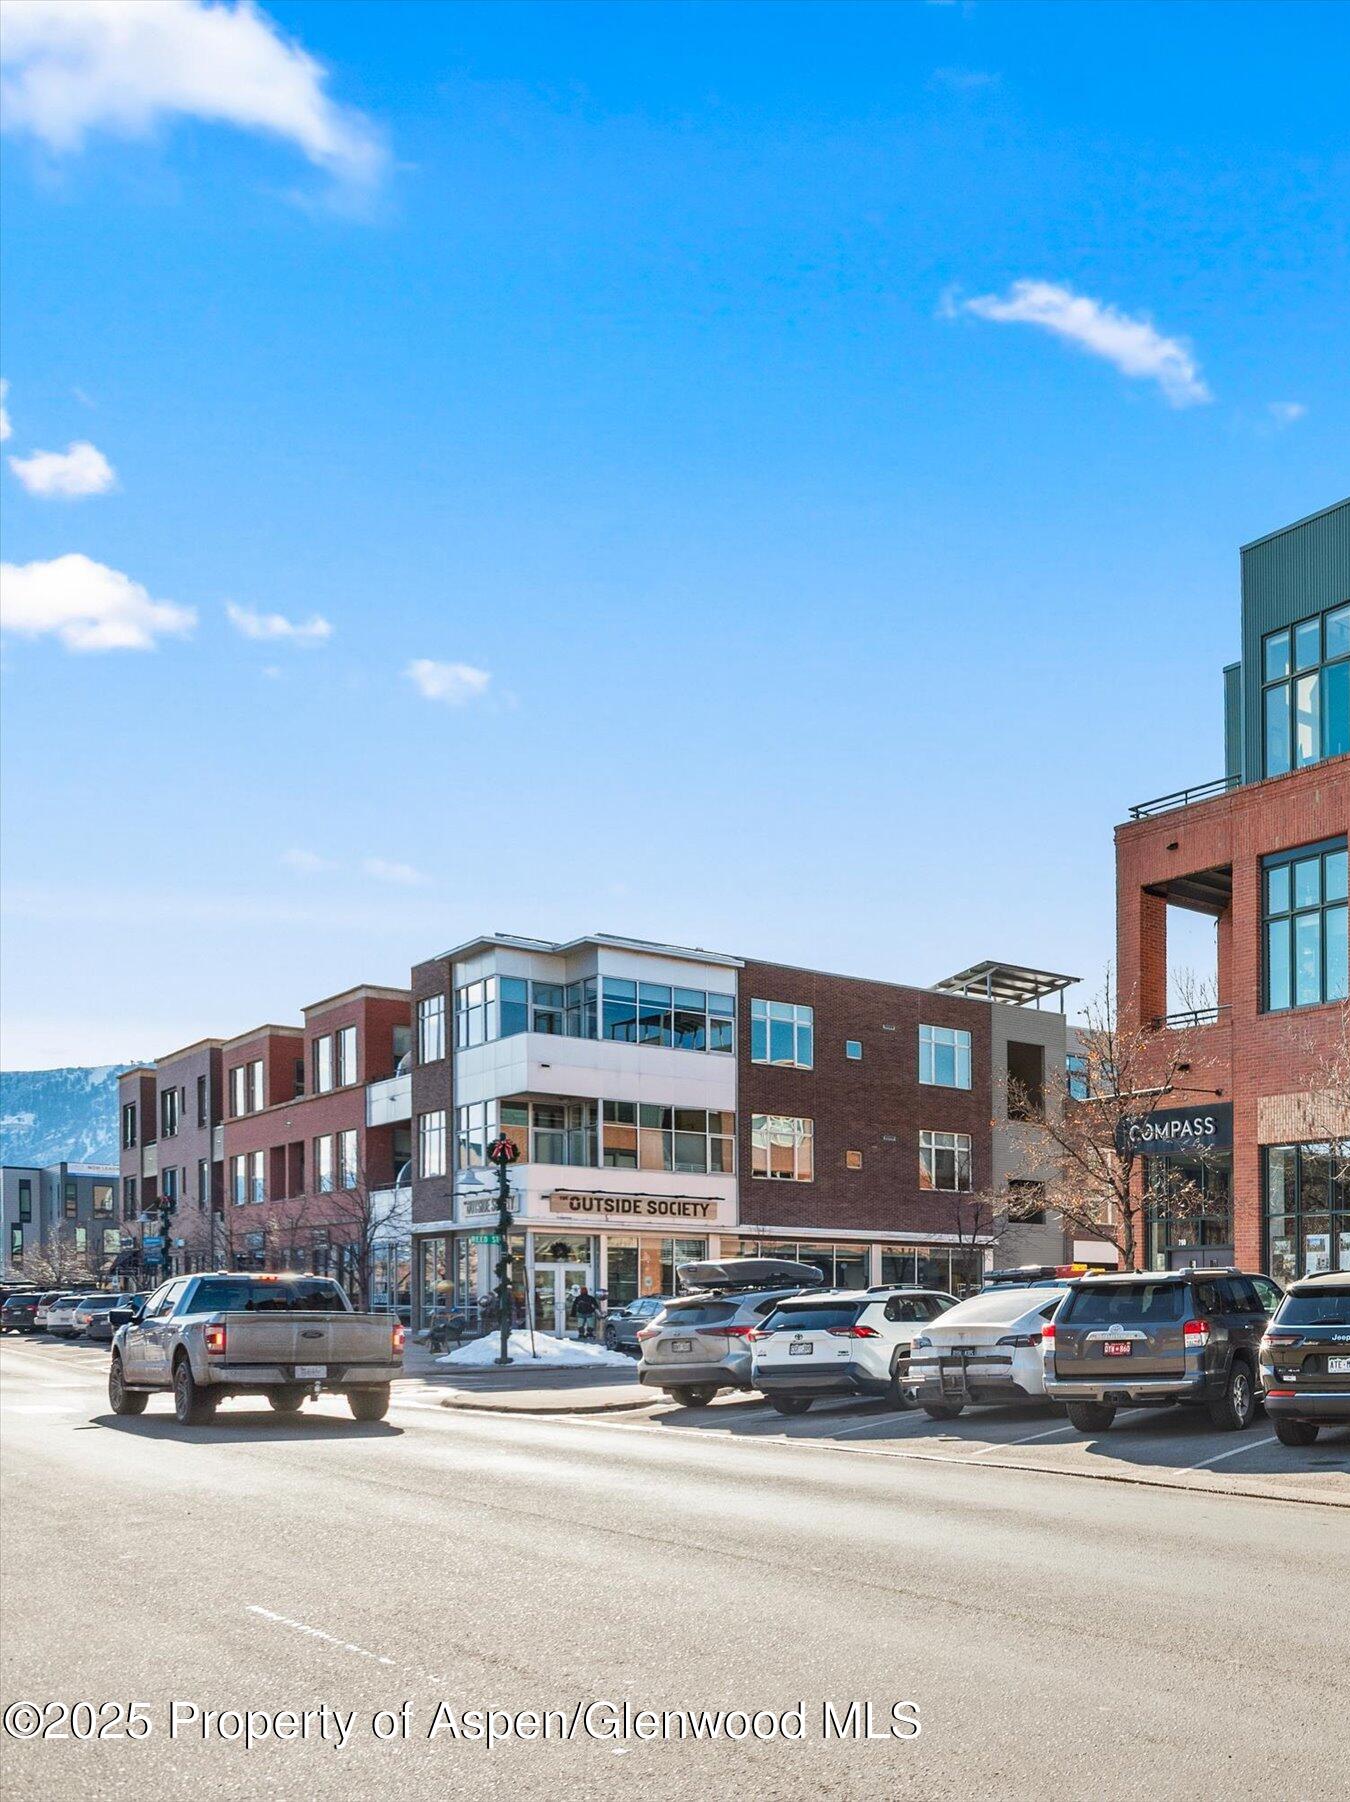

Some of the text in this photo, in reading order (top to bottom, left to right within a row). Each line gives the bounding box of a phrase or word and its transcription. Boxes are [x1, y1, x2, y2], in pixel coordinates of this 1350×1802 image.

[1129, 1117, 1216, 1142] COMPASS
[569, 1196, 642, 1214] OUTSIDE
[647, 1201, 710, 1217] SOCIETY
